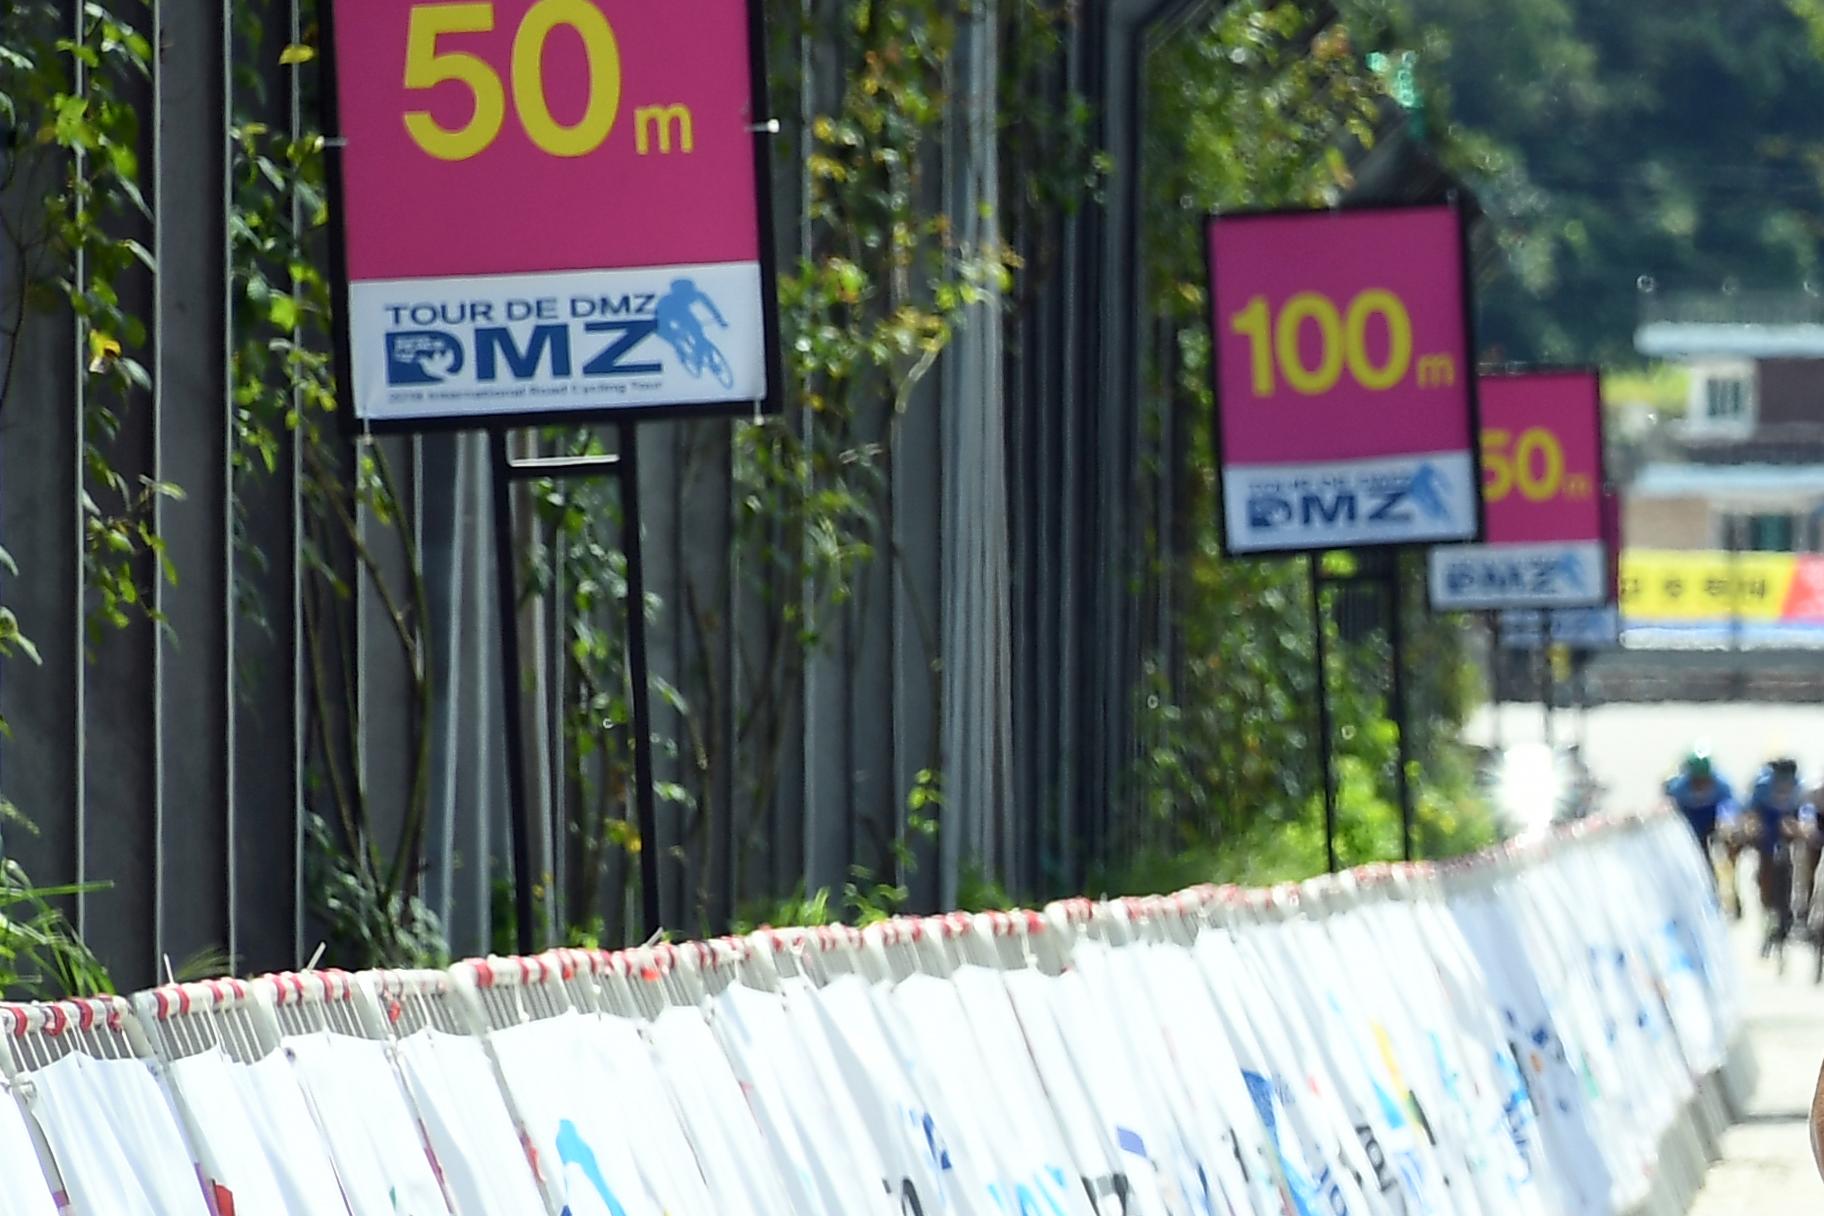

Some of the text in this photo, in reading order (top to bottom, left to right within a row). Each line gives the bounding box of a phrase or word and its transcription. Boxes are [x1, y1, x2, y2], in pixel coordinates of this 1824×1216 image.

[403, 0, 693, 161] 50 m
[384, 293, 655, 326] TOUR DE DMZ
[1231, 288, 1455, 396] 100 m
[384, 319, 663, 387] DMZ
[1480, 427, 1564, 502] 50
[1248, 491, 1414, 528] DMZ
